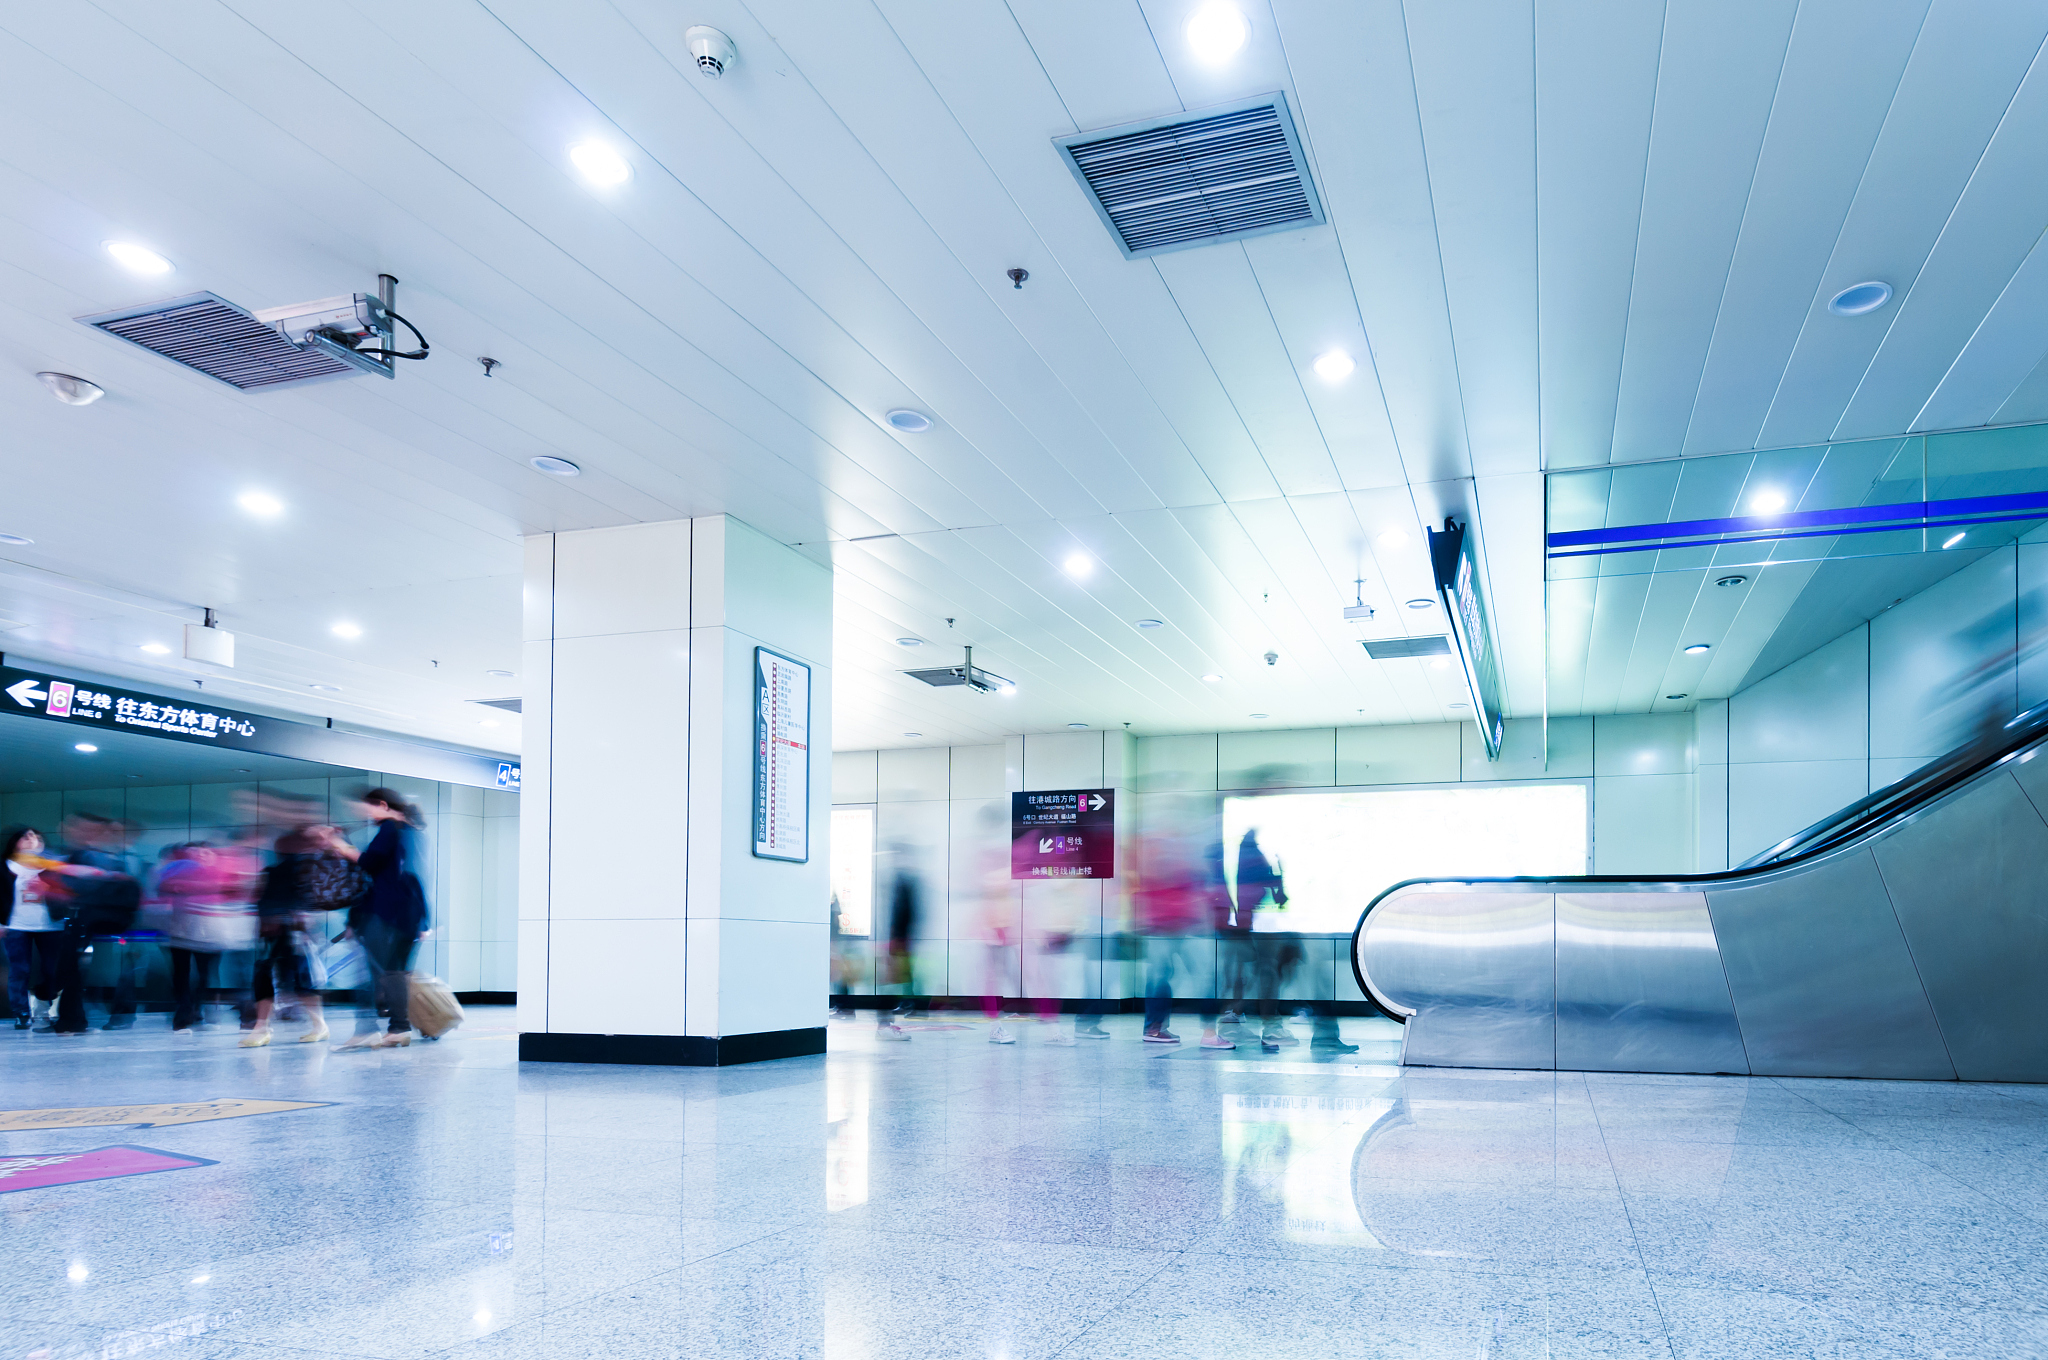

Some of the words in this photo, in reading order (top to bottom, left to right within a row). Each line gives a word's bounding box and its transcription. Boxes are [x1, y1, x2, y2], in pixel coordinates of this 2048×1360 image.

[52, 690, 68, 708] 6
[74, 690, 112, 710] 号线
[115, 697, 256, 737] 往东方体育中心
[71, 707, 95, 718] LINE
[94, 711, 102, 719] 6
[114, 714, 127, 723] To
[126, 716, 161, 729] Oriental
[161, 722, 189, 734] Sports
[189, 727, 218, 738] Center
[499, 770, 507, 782] 4
[511, 768, 522, 779] 号
[1079, 798, 1086, 807] 6
[1057, 841, 1064, 849] 4
[1066, 836, 1083, 846] 号线
